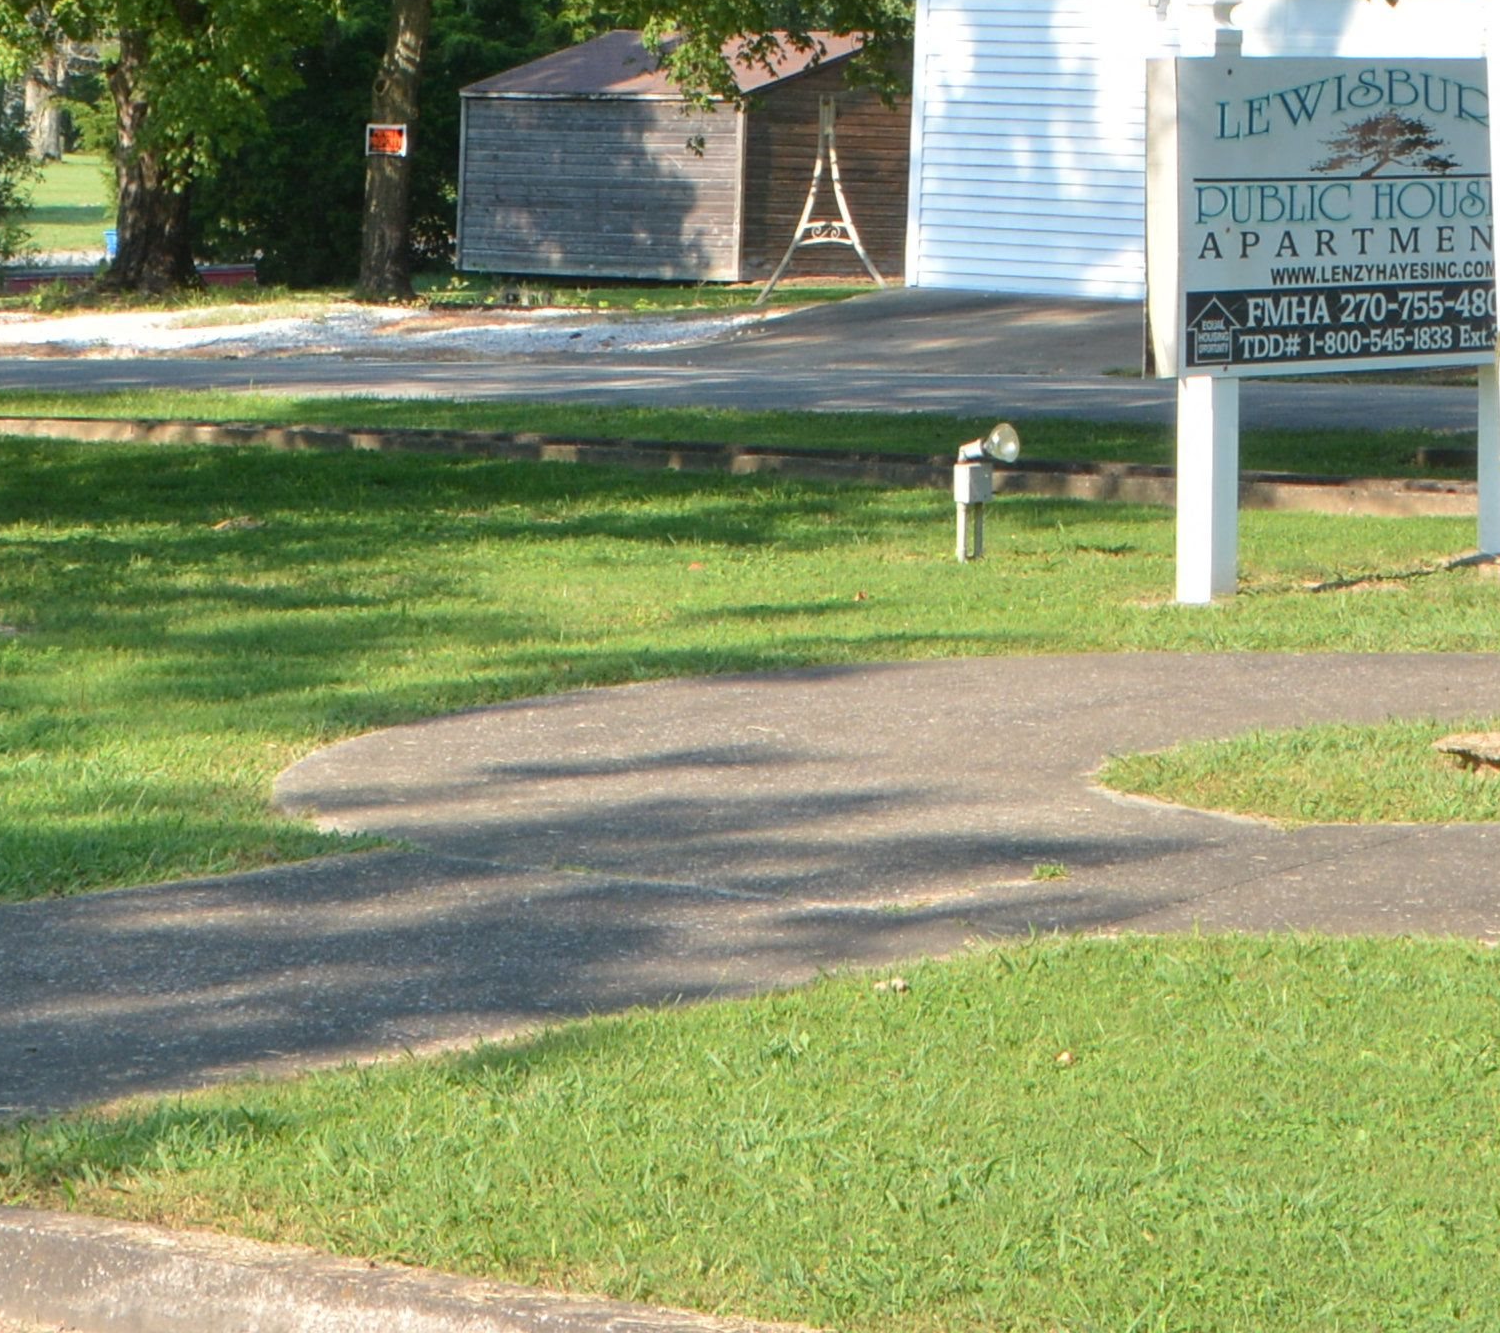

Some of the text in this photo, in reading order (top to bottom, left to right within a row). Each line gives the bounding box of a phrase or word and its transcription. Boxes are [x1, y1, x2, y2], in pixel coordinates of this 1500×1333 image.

[1195, 183, 1352, 225] PUBLIC
[1247, 287, 1498, 327] FMHA 270-755-480
[1239, 333, 1301, 359] TDD#
[1308, 326, 1452, 356] 1-800-545-1833
